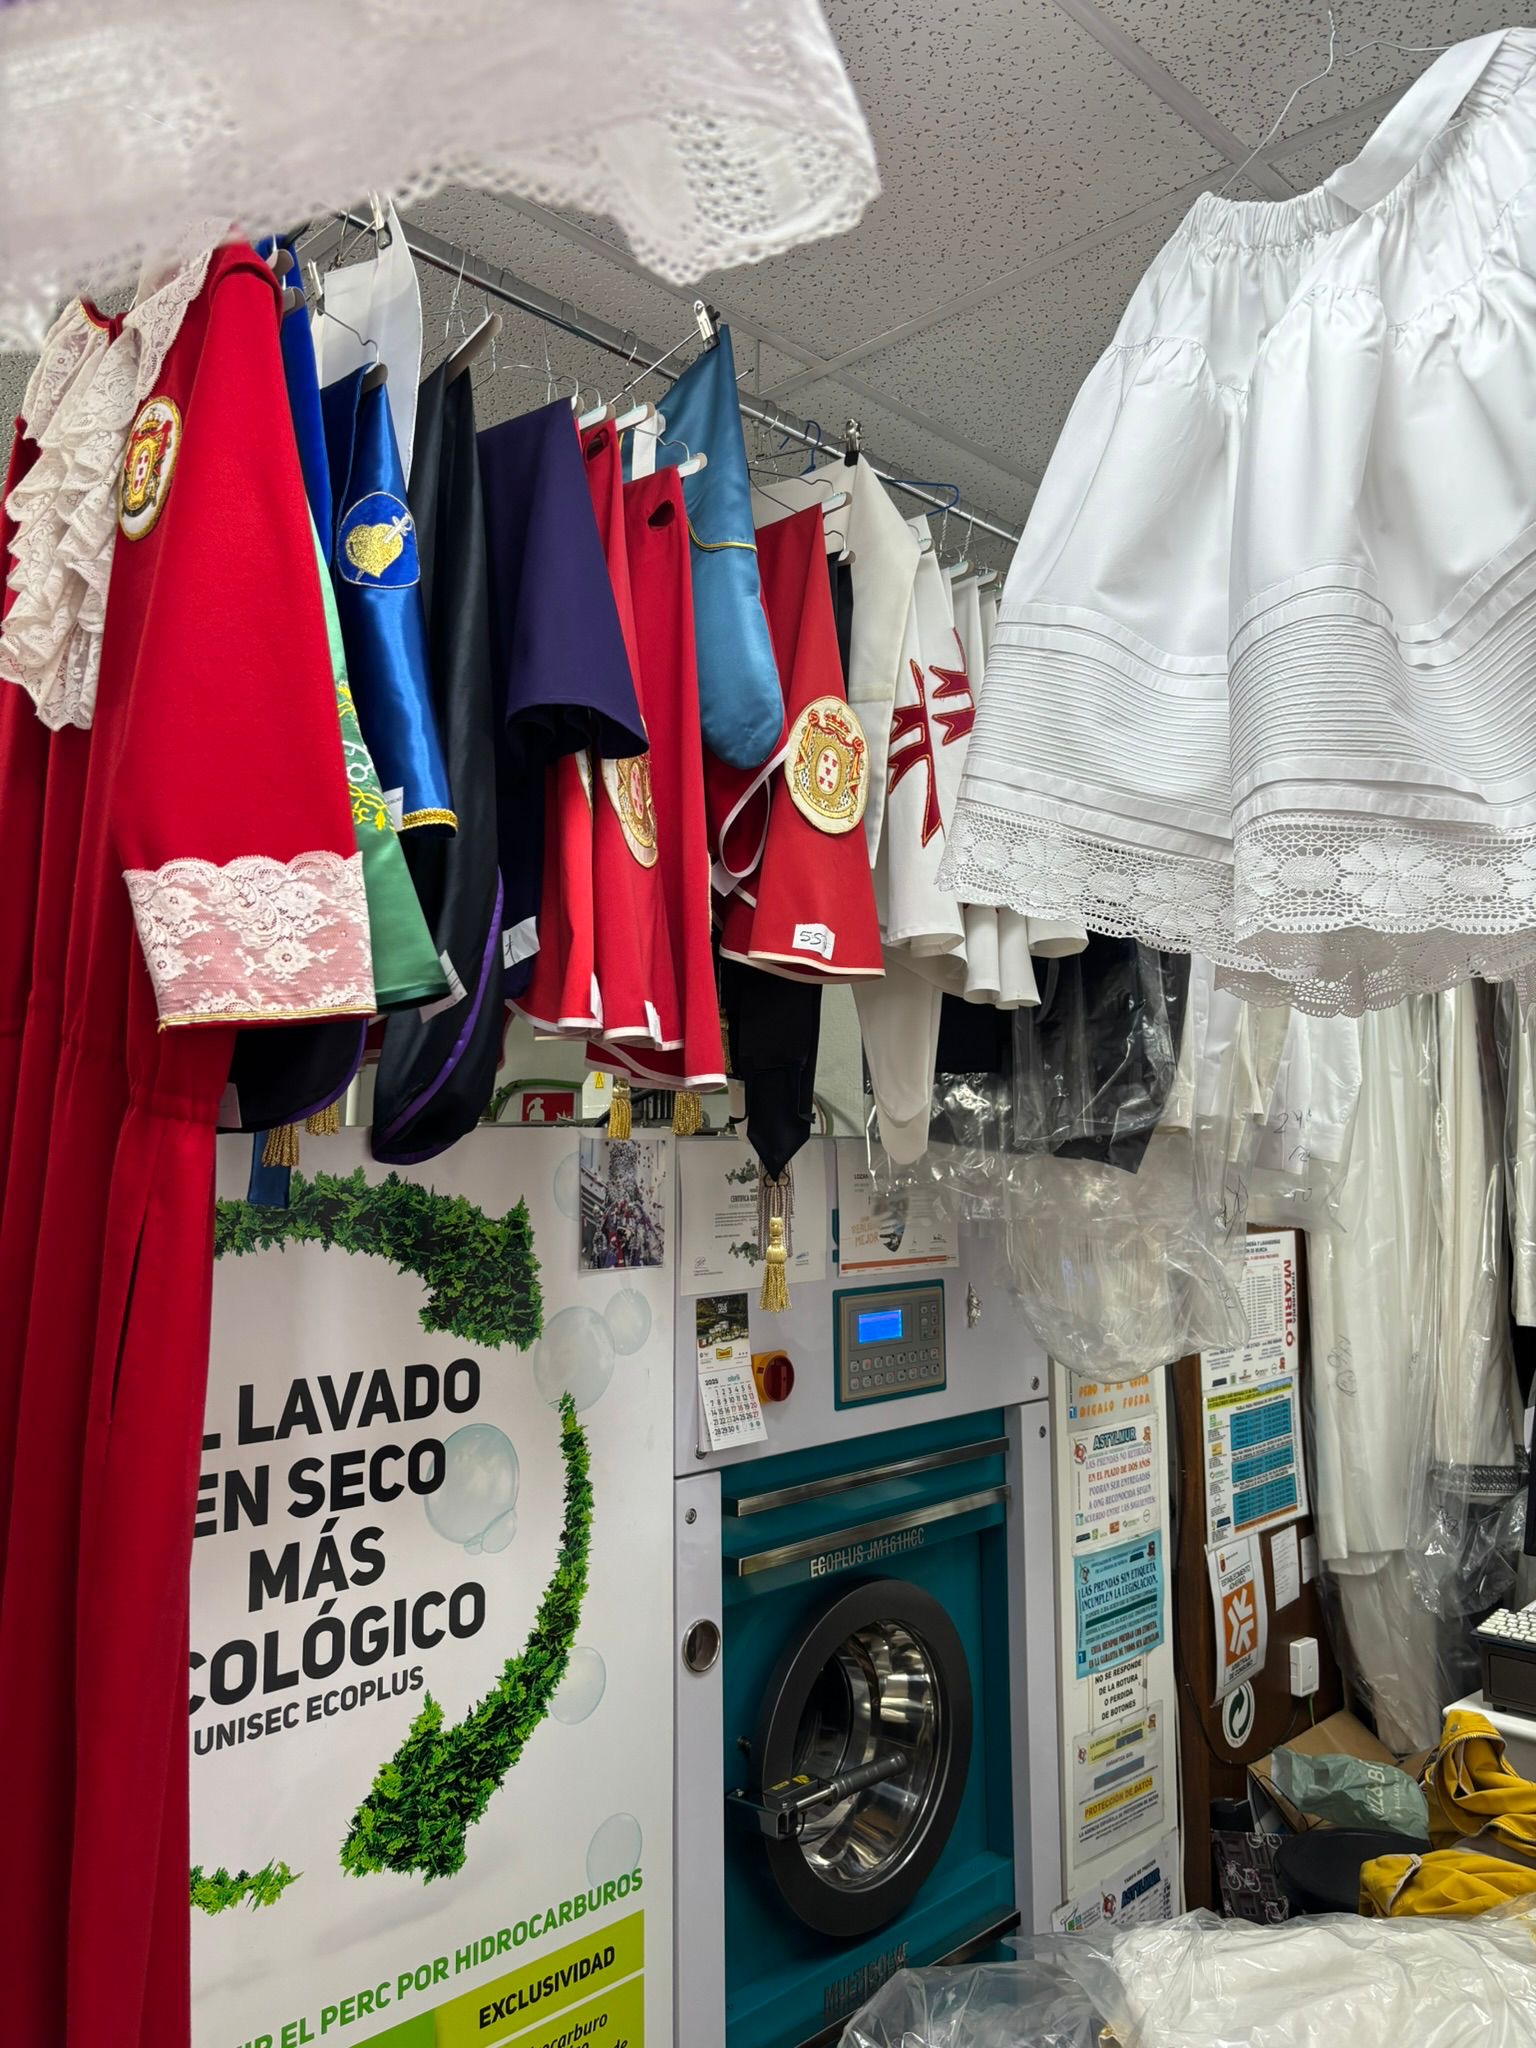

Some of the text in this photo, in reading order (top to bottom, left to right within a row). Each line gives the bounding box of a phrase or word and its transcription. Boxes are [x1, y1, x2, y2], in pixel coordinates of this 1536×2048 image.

[1284, 1260, 1296, 1347] MARILÓ
[728, 1374, 740, 1382] abril
[238, 1358, 481, 1445] LAVADO
[1080, 1400, 1114, 1417] DIGALO
[287, 1438, 447, 1519] SECO
[1088, 1473, 1096, 1482] EN
[1096, 1471, 1103, 1480] EL
[1104, 1466, 1120, 1478] PLAZO
[1120, 1465, 1127, 1473] DE
[1129, 1462, 1138, 1472] DOS
[248, 1516, 386, 1613] MÁS
[810, 1544, 865, 1578] ECOPLUS
[1082, 1562, 1156, 1598] LAS PRENDAS SIN ETIQUETA
[1095, 1659, 1142, 1684] NO SE RESPONDE
[1099, 1674, 1138, 1696] DE LA ROTURA
[193, 1665, 424, 1757] UNISEC ECOPLUS
[1102, 1699, 1136, 1720] DE BOTONES
[1110, 1688, 1133, 1704] PERDIDA
[1085, 1777, 1152, 1819] PROTECCIÓN DE DATOS
[281, 1867, 644, 2048] EL PERC POR HIDROCARBUROS
[479, 1945, 615, 2030] EXCLUSIVIDAD
